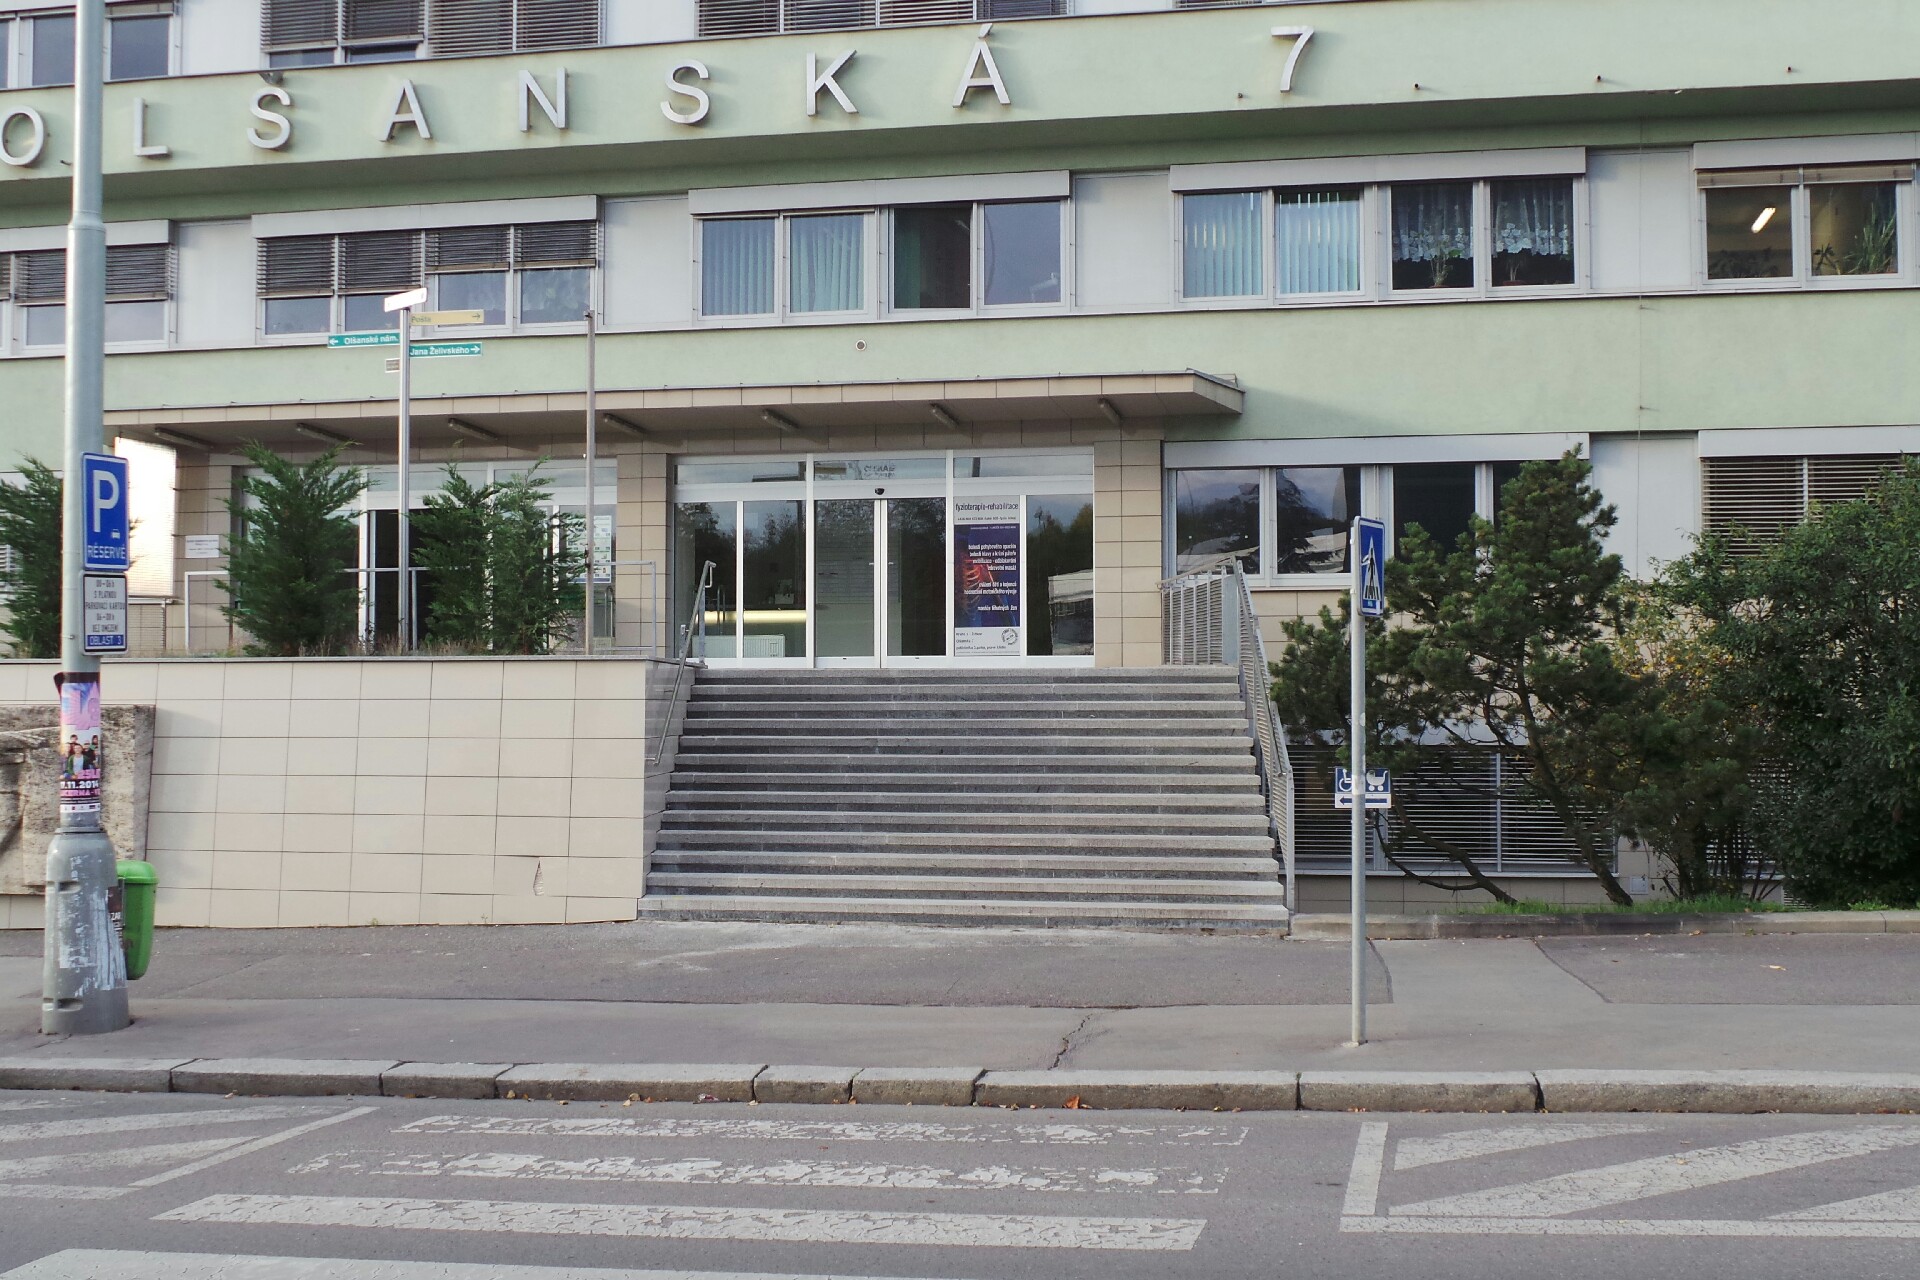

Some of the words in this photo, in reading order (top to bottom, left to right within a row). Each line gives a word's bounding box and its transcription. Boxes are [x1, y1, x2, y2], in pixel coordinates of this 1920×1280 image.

[1271, 25, 1314, 93] 7
[344, 334, 379, 345] Olšanské
[380, 334, 398, 343] nám.
[410, 348, 428, 356] Jana
[429, 345, 470, 355] Želivského
[93, 469, 119, 532] P
[88, 542, 126, 559] RÉSERVÉ
[98, 590, 117, 598] PLATNOU
[89, 635, 114, 645] OBLAST
[117, 635, 122, 645] 3
